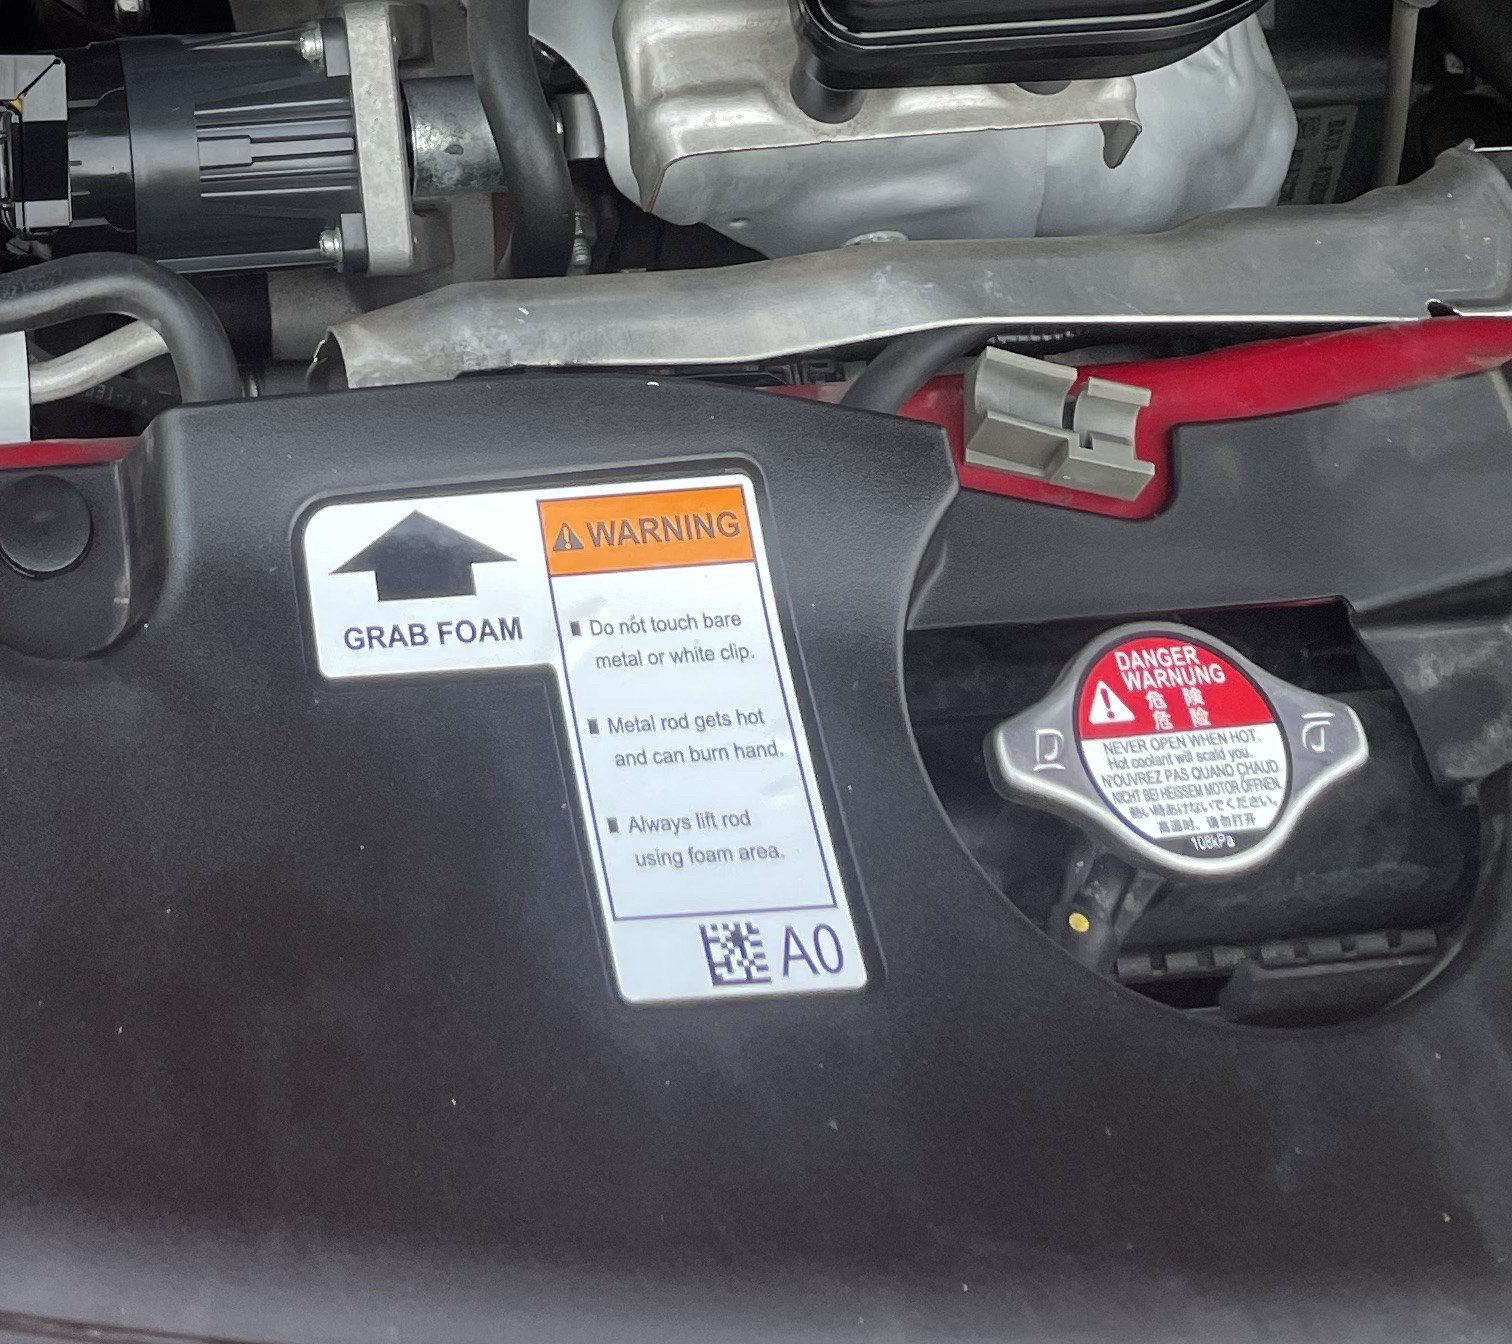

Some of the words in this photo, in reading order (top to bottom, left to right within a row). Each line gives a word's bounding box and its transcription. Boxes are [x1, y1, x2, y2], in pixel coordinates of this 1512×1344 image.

[586, 510, 741, 548] WARNING
[343, 622, 429, 651] GRAB
[436, 616, 524, 646] FOAM
[589, 618, 614, 636] Do
[619, 616, 646, 634] not
[650, 613, 699, 633] touch
[702, 612, 742, 629] bare
[595, 650, 643, 669] metal
[647, 651, 666, 666] or
[670, 646, 715, 663] white
[720, 643, 755, 663] clip.
[1114, 645, 1200, 671] DANGER
[1121, 663, 1226, 691] WARNUNG
[607, 714, 656, 735] Metal
[661, 712, 689, 731] rod
[694, 711, 732, 733] gets
[736, 708, 766, 726] hot
[614, 748, 647, 767] and
[652, 749, 685, 765] can
[689, 745, 729, 763] burn
[733, 740, 784, 760] hand.
[1102, 740, 1148, 756] NEVER
[1150, 736, 1187, 751] OPEN
[1188, 732, 1229, 748] WHEN
[1107, 757, 1128, 771] Hot
[1132, 752, 1173, 768] coolant
[1174, 750, 1194, 764] will
[1196, 746, 1226, 762] scald
[1165, 767, 1189, 782] PAS
[1191, 763, 1235, 780] QUAND
[1111, 789, 1142, 805] NICHT
[1143, 787, 1159, 801] BEI
[1161, 784, 1203, 800] HEISSEM
[1204, 780, 1239, 797] MOTOR
[629, 815, 692, 836] Always
[695, 811, 718, 830] lift
[721, 809, 752, 828] rod
[634, 848, 684, 869] using
[687, 846, 734, 865] foam
[739, 844, 785, 861] area.
[782, 922, 845, 977] A0
